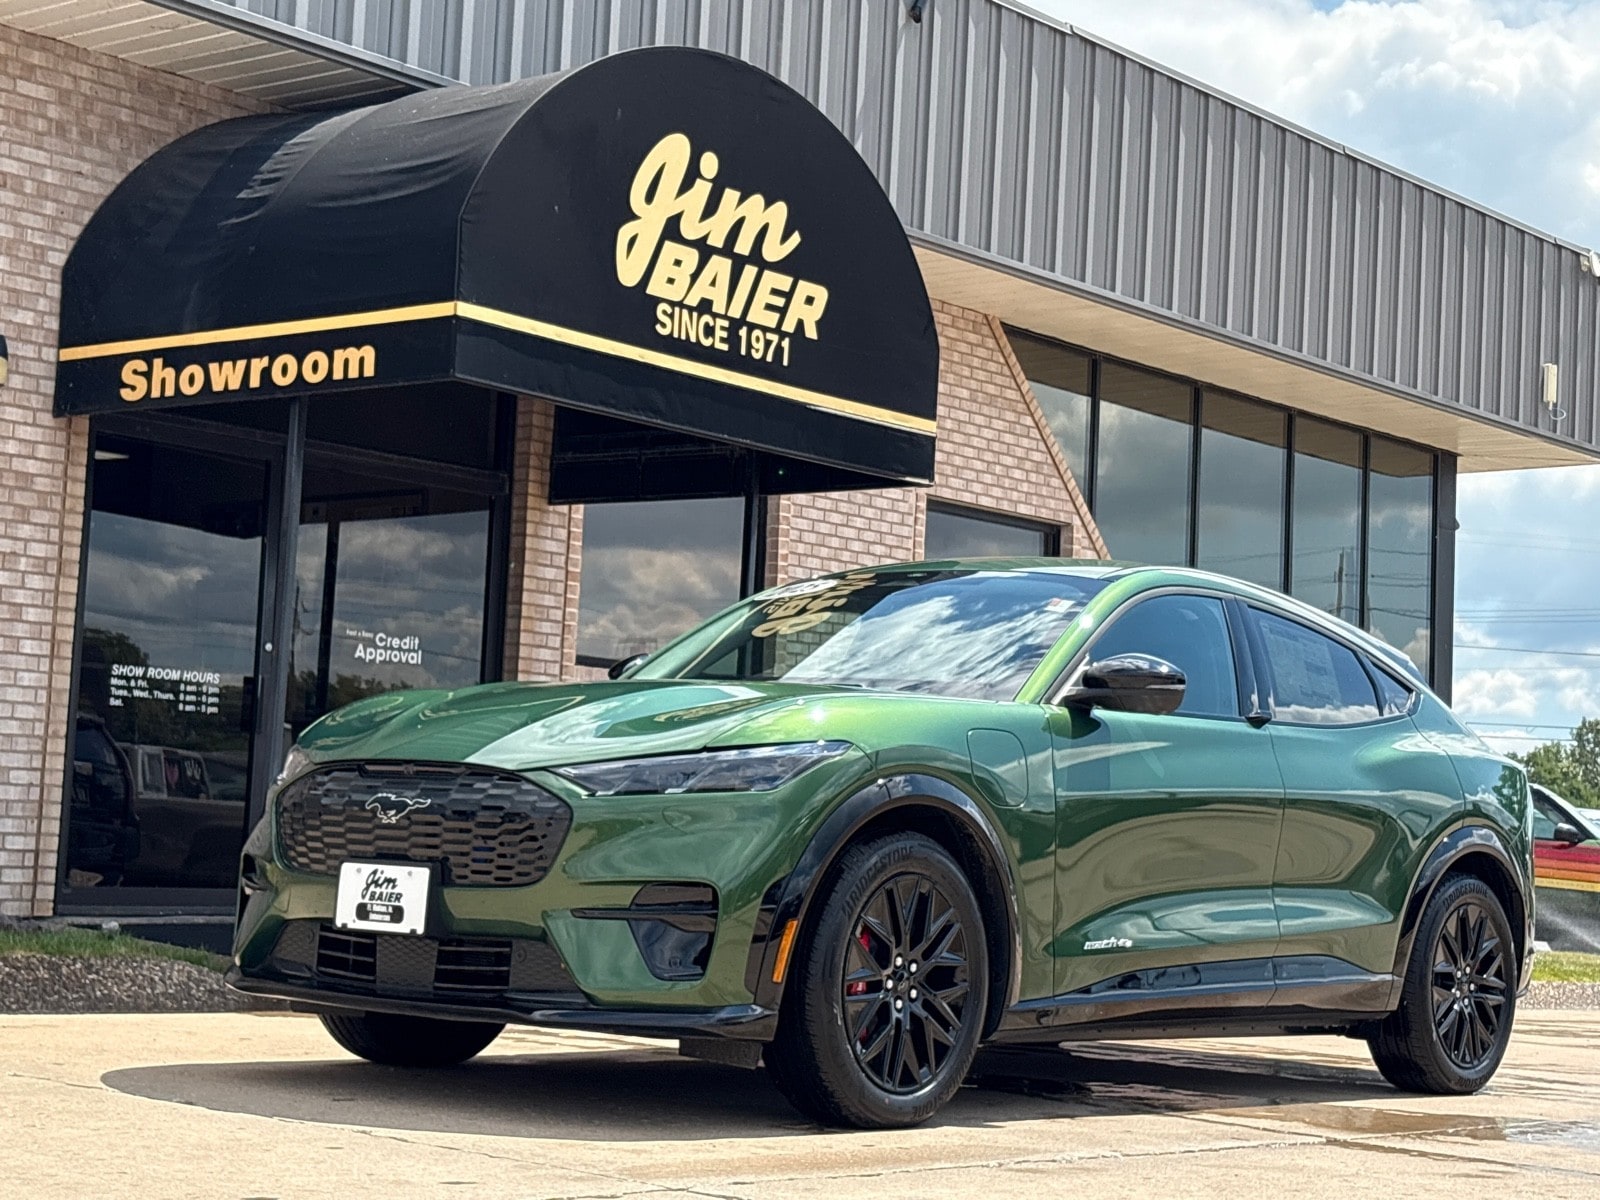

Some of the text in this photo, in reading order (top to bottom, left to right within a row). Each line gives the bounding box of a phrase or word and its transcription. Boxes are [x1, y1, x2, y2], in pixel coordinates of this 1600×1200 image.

[615, 132, 801, 288] Jim
[645, 239, 829, 341] BAIER
[655, 302, 790, 367] SINCE 1971
[119, 345, 376, 401] Showroom
[354, 643, 422, 665] Approval
[375, 632, 420, 650] Credit
[110, 677, 128, 687] Mon.
[137, 679, 149, 688] Fri.
[111, 664, 220, 684] SHOW ROOM HOURS
[361, 868, 398, 900] Jim
[368, 890, 403, 904] BAIER
